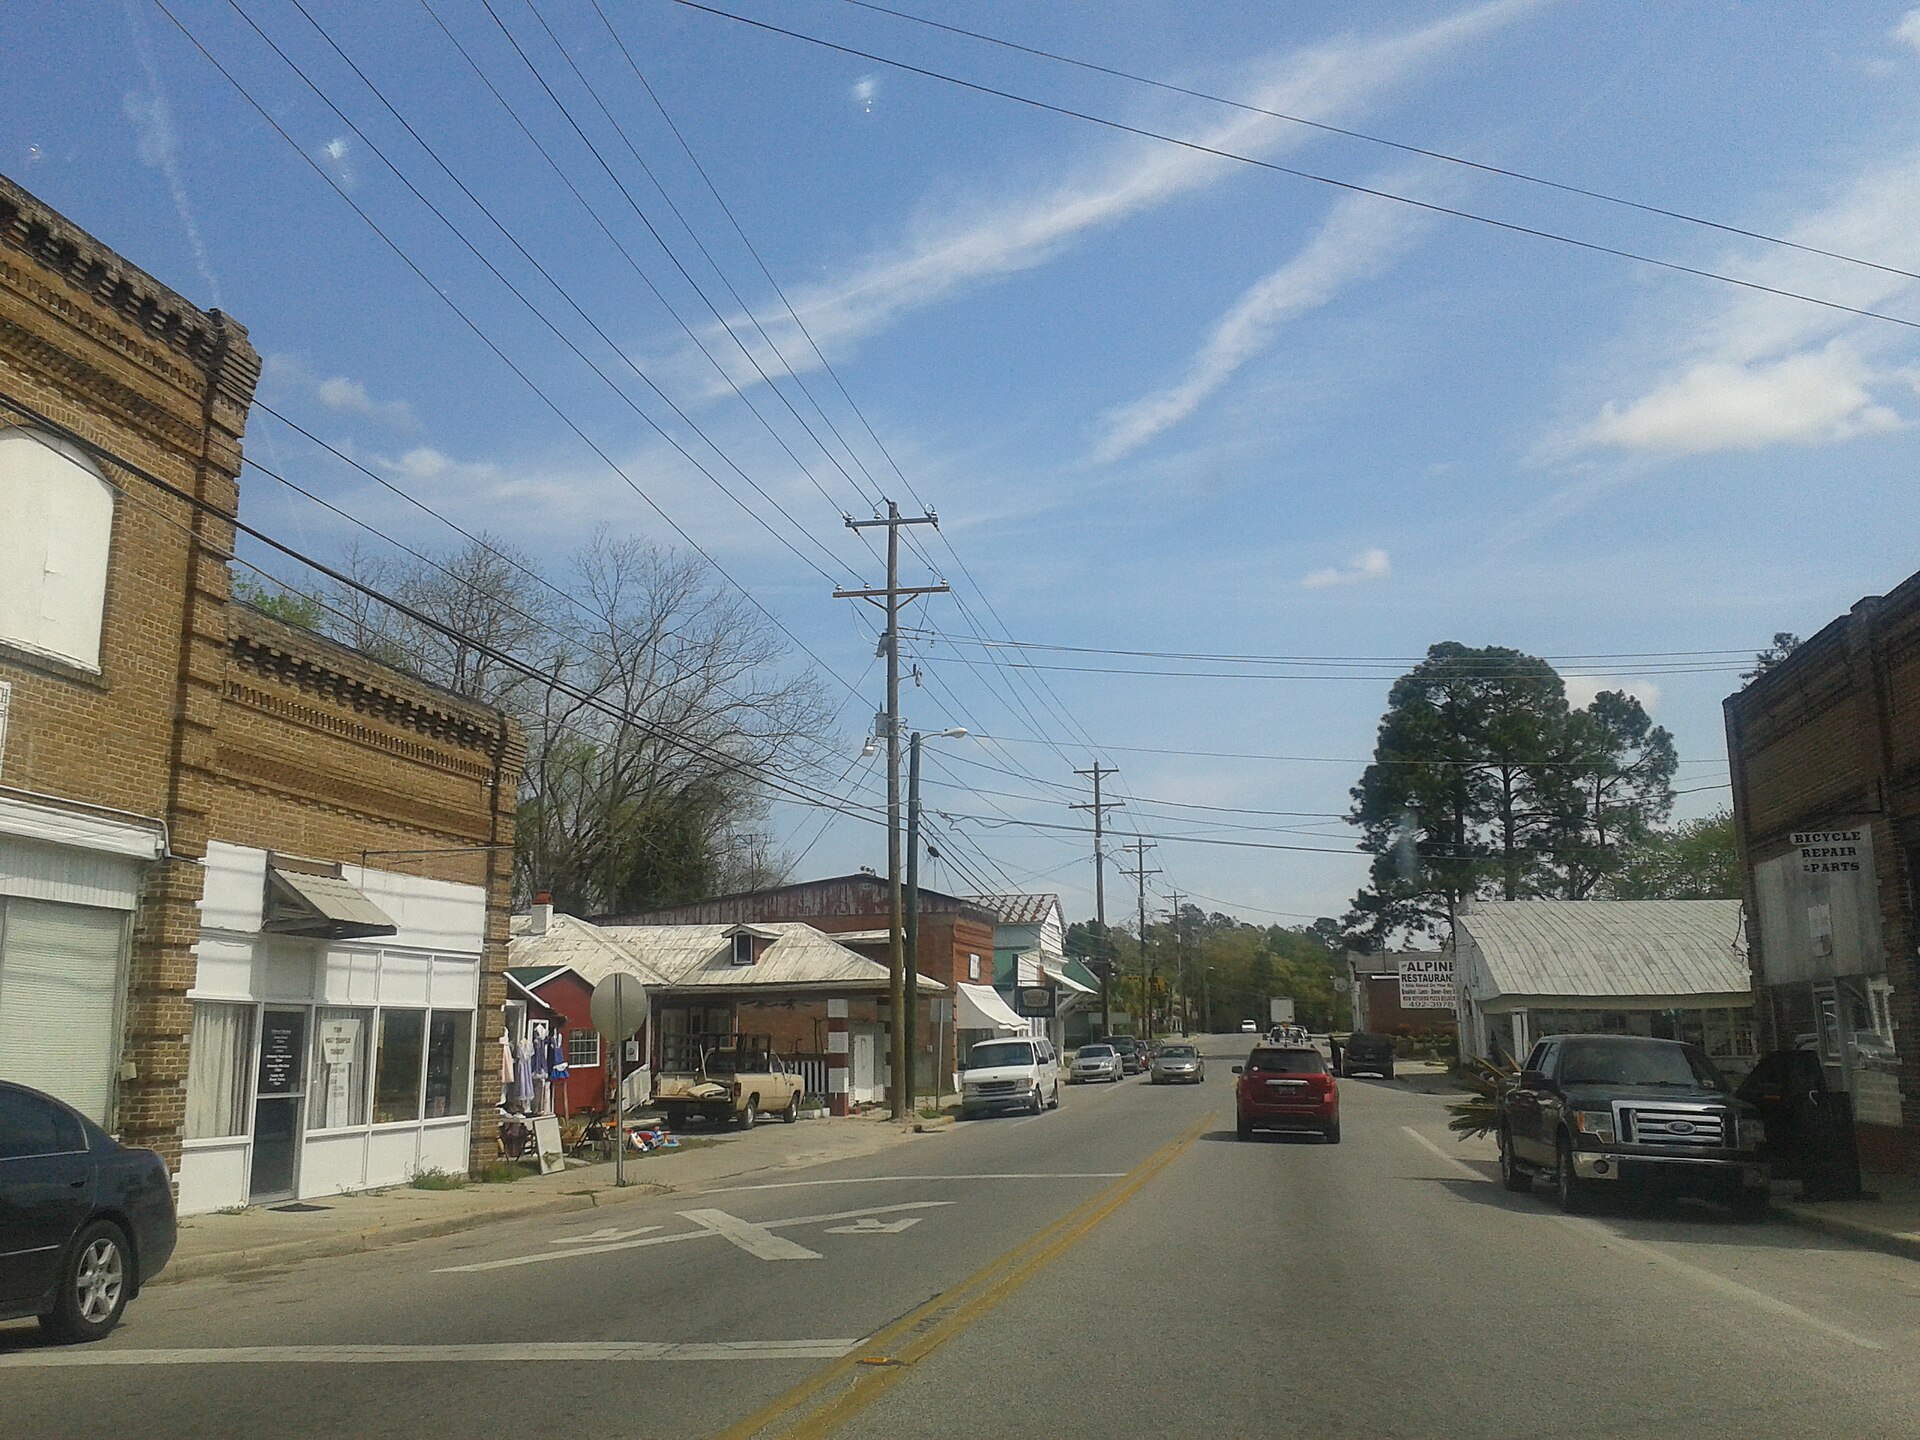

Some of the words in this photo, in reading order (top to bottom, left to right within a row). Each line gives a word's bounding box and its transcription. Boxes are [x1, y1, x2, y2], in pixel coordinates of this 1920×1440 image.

[1794, 832, 1861, 844] BICYCLE
[1801, 847, 1857, 858] REPAIR
[1407, 961, 1454, 972] ALPINE
